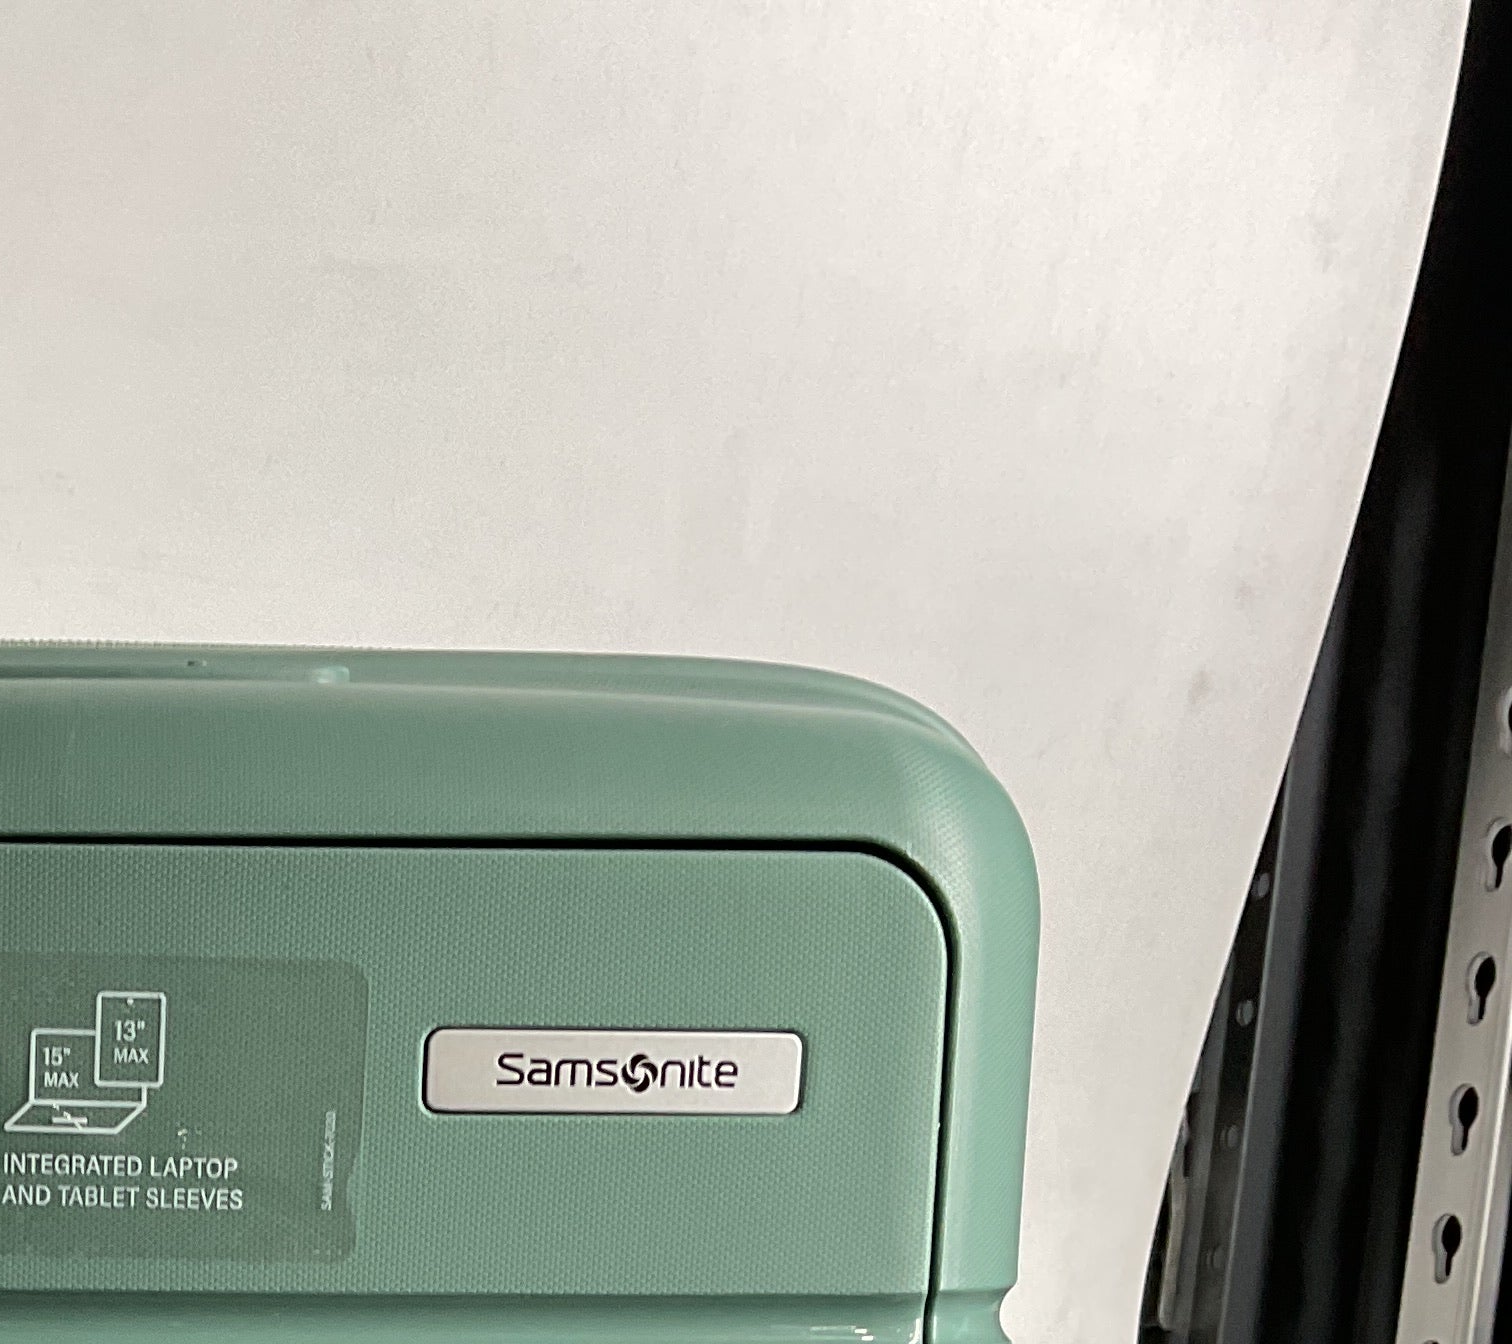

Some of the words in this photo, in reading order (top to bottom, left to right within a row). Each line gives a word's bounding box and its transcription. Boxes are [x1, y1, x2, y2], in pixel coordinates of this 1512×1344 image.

[114, 1019, 146, 1042] 13"
[42, 1046, 72, 1067] 15"
[113, 1047, 149, 1065] MAX
[44, 1071, 80, 1089] MAX
[495, 1051, 740, 1093] Samsonite
[3, 1152, 143, 1177] INTEGRATED
[150, 1155, 239, 1180] LAPTOP
[1, 1184, 51, 1207] AND
[58, 1184, 140, 1209] TABLET
[145, 1186, 244, 1212] SLEEVES
